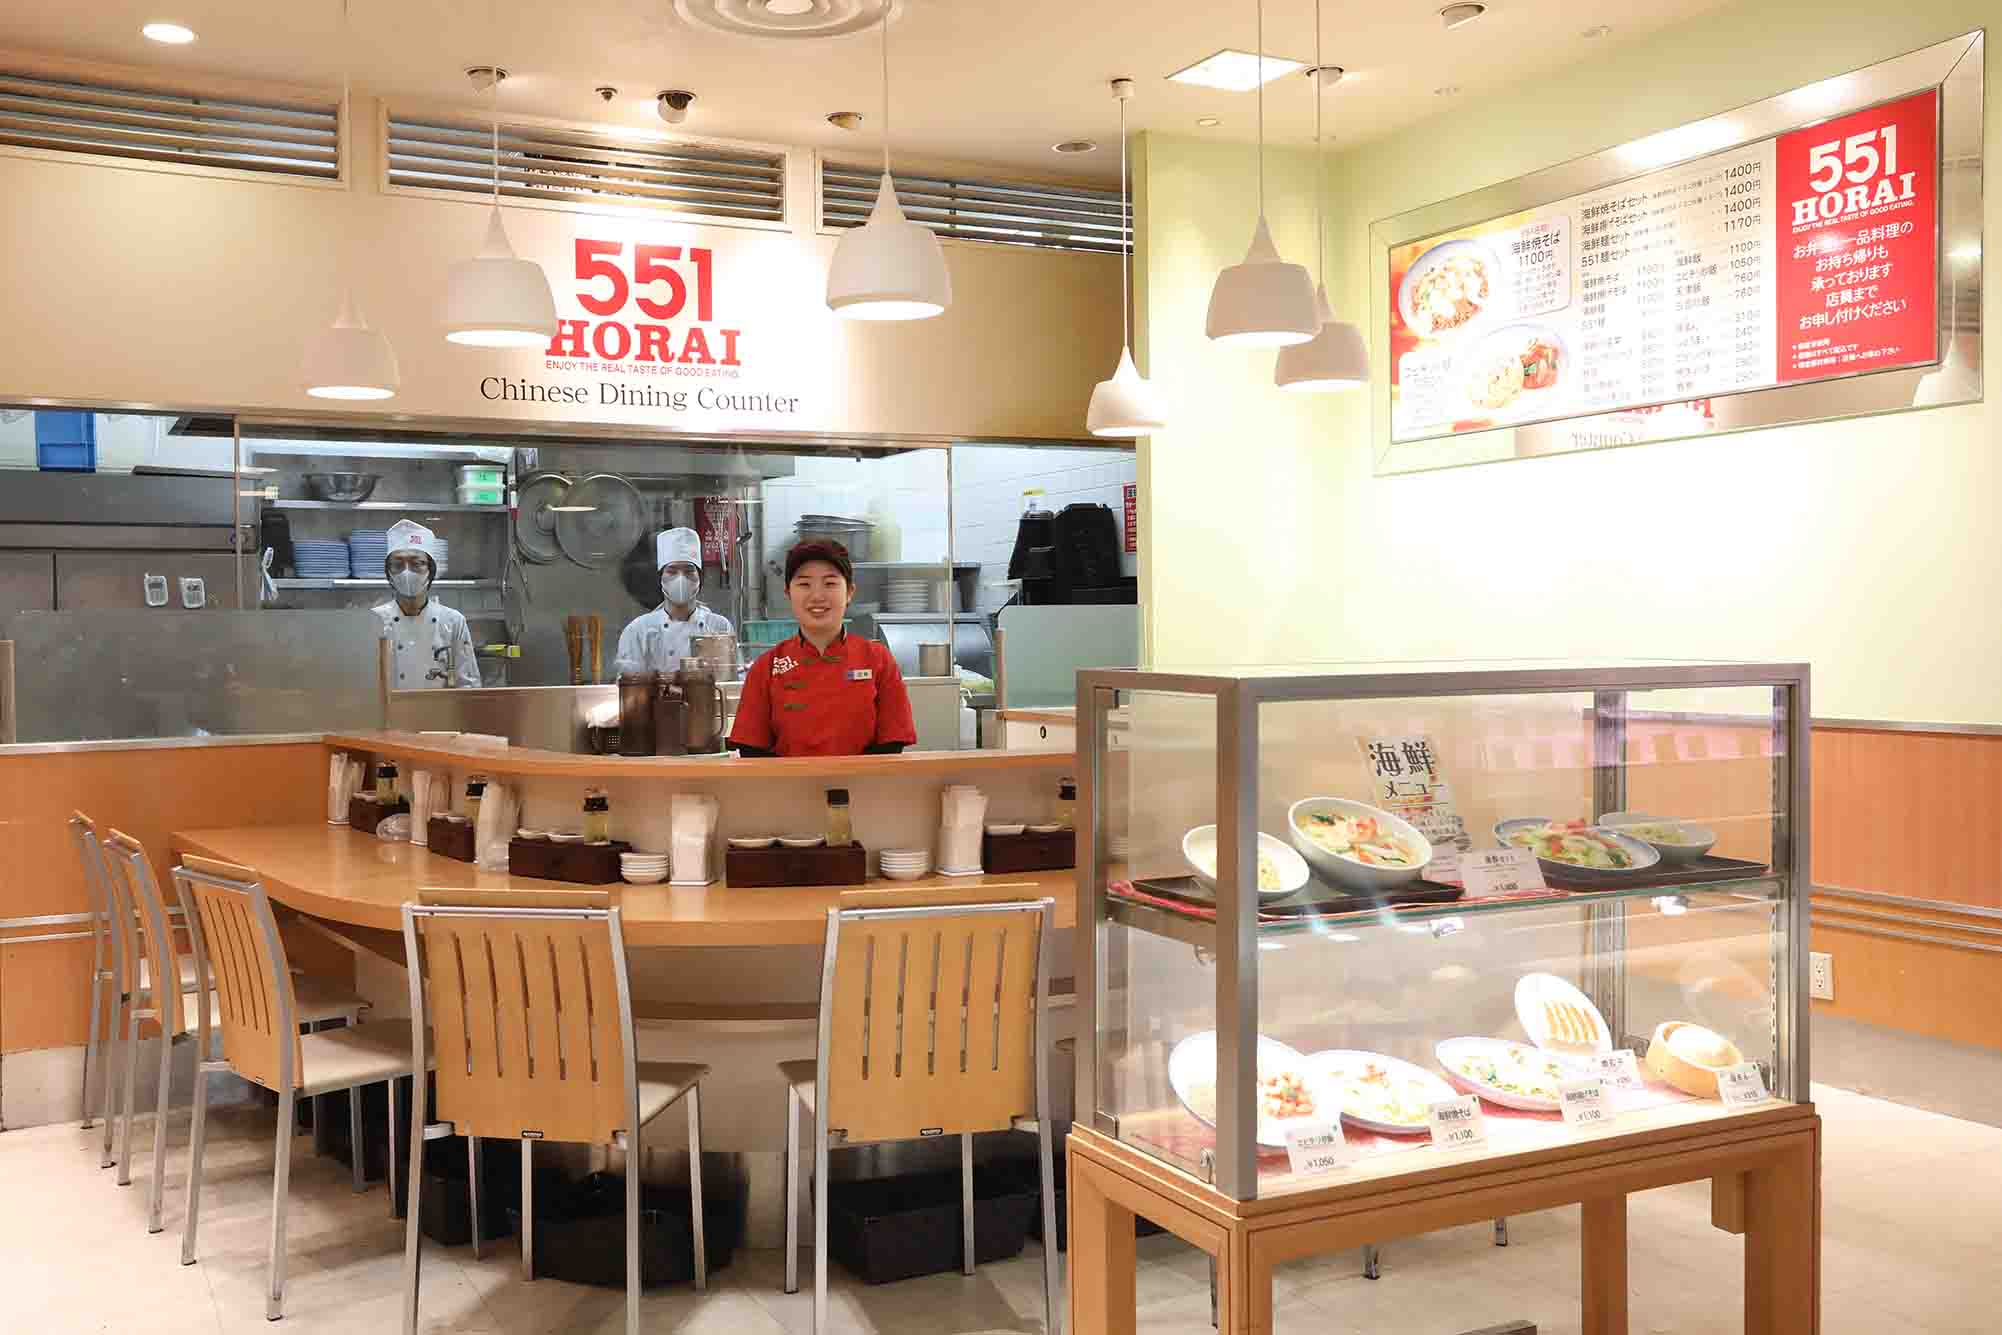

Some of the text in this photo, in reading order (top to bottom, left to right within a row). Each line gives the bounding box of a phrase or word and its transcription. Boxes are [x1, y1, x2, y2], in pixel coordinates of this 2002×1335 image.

[1809, 124, 1897, 193] 551
[1724, 161, 1760, 182] 1400円
[1724, 179, 1760, 199] 1400円
[1792, 171, 1916, 227] HORAI
[1724, 196, 1760, 215] 1400円
[1723, 214, 1760, 233] 1170円
[1519, 249, 1553, 267] 1100円
[1730, 240, 1760, 256] 1100円
[1815, 244, 1889, 272] お持ち帰りも
[1730, 255, 1760, 270] 1050円
[575, 238, 712, 322] 551
[1811, 263, 1893, 291] 承っております
[1825, 285, 1878, 307] 店員まで
[1799, 299, 1907, 330] お申し付けください
[545, 319, 741, 367] HORAI
[545, 360, 576, 371] ENJOY
[579, 362, 598, 372] THE
[602, 363, 625, 374] REAL
[628, 365, 657, 375] TASTE
[661, 367, 673, 376] OF
[675, 367, 703, 377] GOOD
[480, 377, 801, 415] Chinese Dining Counter
[1368, 741, 1435, 777] 海鮮
